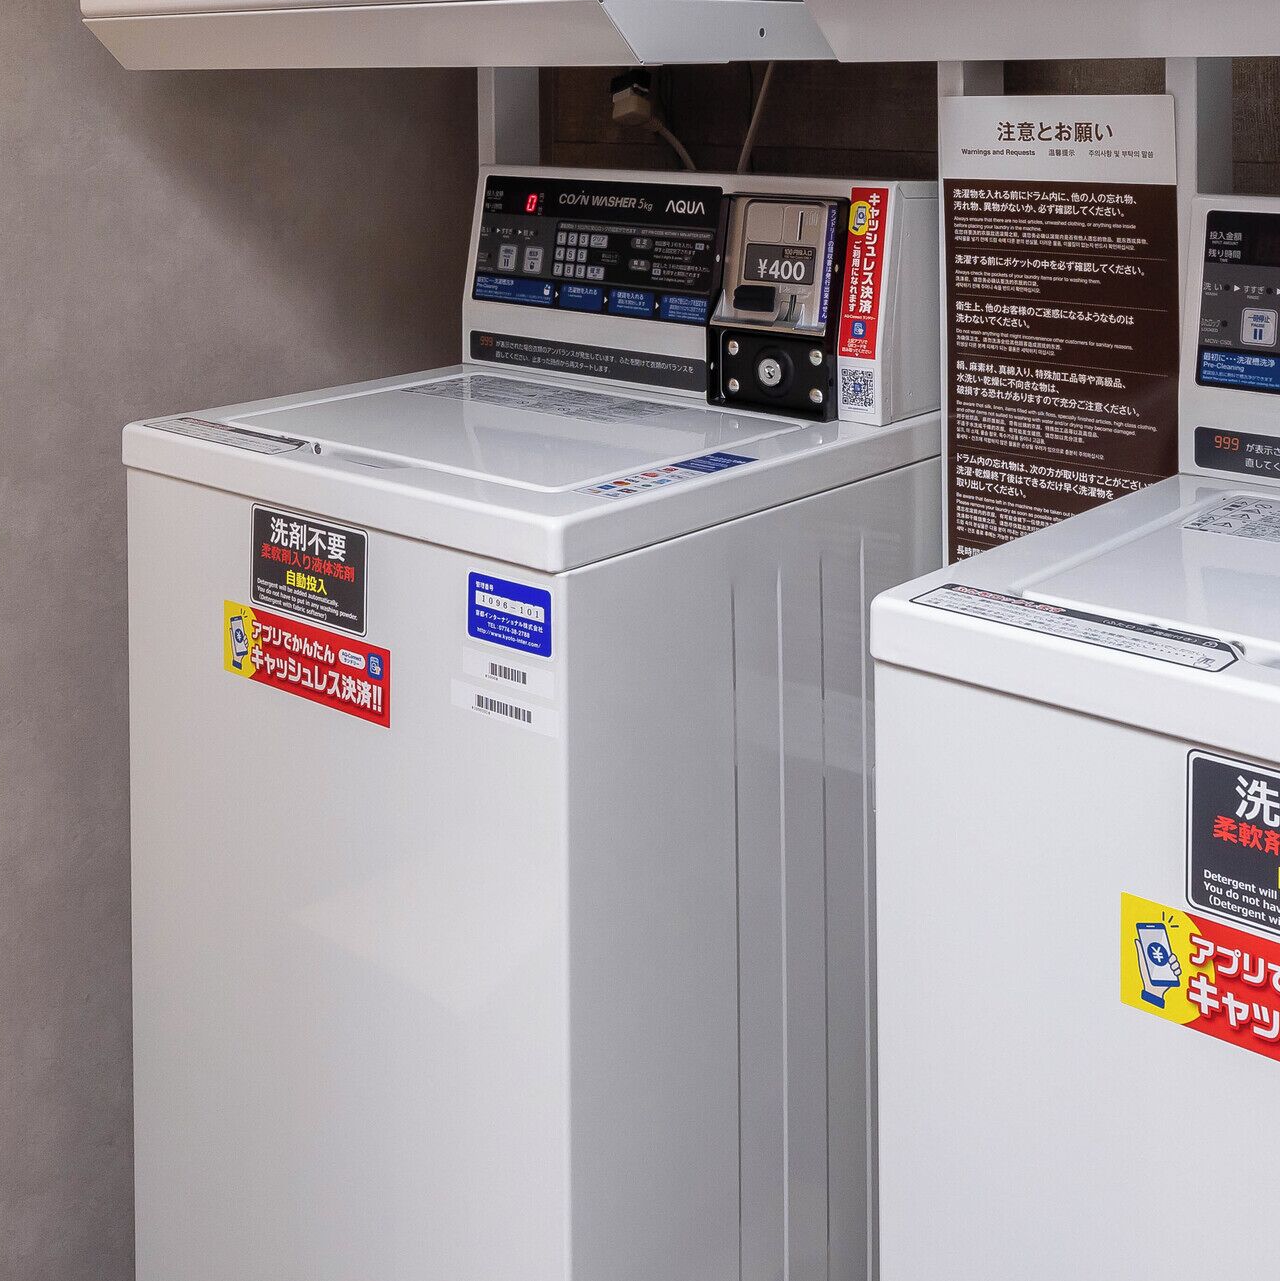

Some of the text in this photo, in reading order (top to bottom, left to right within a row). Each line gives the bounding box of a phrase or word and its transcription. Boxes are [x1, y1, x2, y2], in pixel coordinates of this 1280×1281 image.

[997, 121, 1113, 142] 注意とお願い
[962, 148, 991, 156] Warnings
[526, 193, 538, 212] 0
[592, 195, 637, 209] WASHER
[638, 198, 653, 211] 5kg
[665, 200, 705, 215] AQUA
[953, 188, 1137, 205] 洗濯物を入れる前にドラム内に、他の人の忘れ物、
[954, 201, 1125, 218] 汚れ物、異物がないか、必ず確認してください。
[859, 193, 881, 314] キャッシュレス決済
[758, 259, 805, 281] ¥400
[955, 254, 1145, 276] 洗濯する前にポケットの中を必ず確認してください。
[848, 241, 861, 312] ご利用になれます
[956, 301, 1134, 325] 衛生上、他のお客様のご迷惑になるようなものは
[956, 313, 1031, 329] 洗わないでください。
[479, 336, 494, 346] 999
[1203, 362, 1245, 373] Pre-Cleaning
[957, 477, 1027, 499] 取り出してください。
[270, 516, 347, 562] 洗剤不要
[261, 543, 355, 583] 柔軟剤入り液体洗剤
[286, 570, 328, 596] 自動投入
[252, 621, 335, 664] アプリでかんたん
[1203, 869, 1255, 897] Detergent
[1258, 884, 1277, 901] will
[1203, 882, 1222, 897] You
[1226, 887, 1238, 901] do
[1241, 892, 1259, 908] not
[1208, 894, 1266, 923] (Detergent
